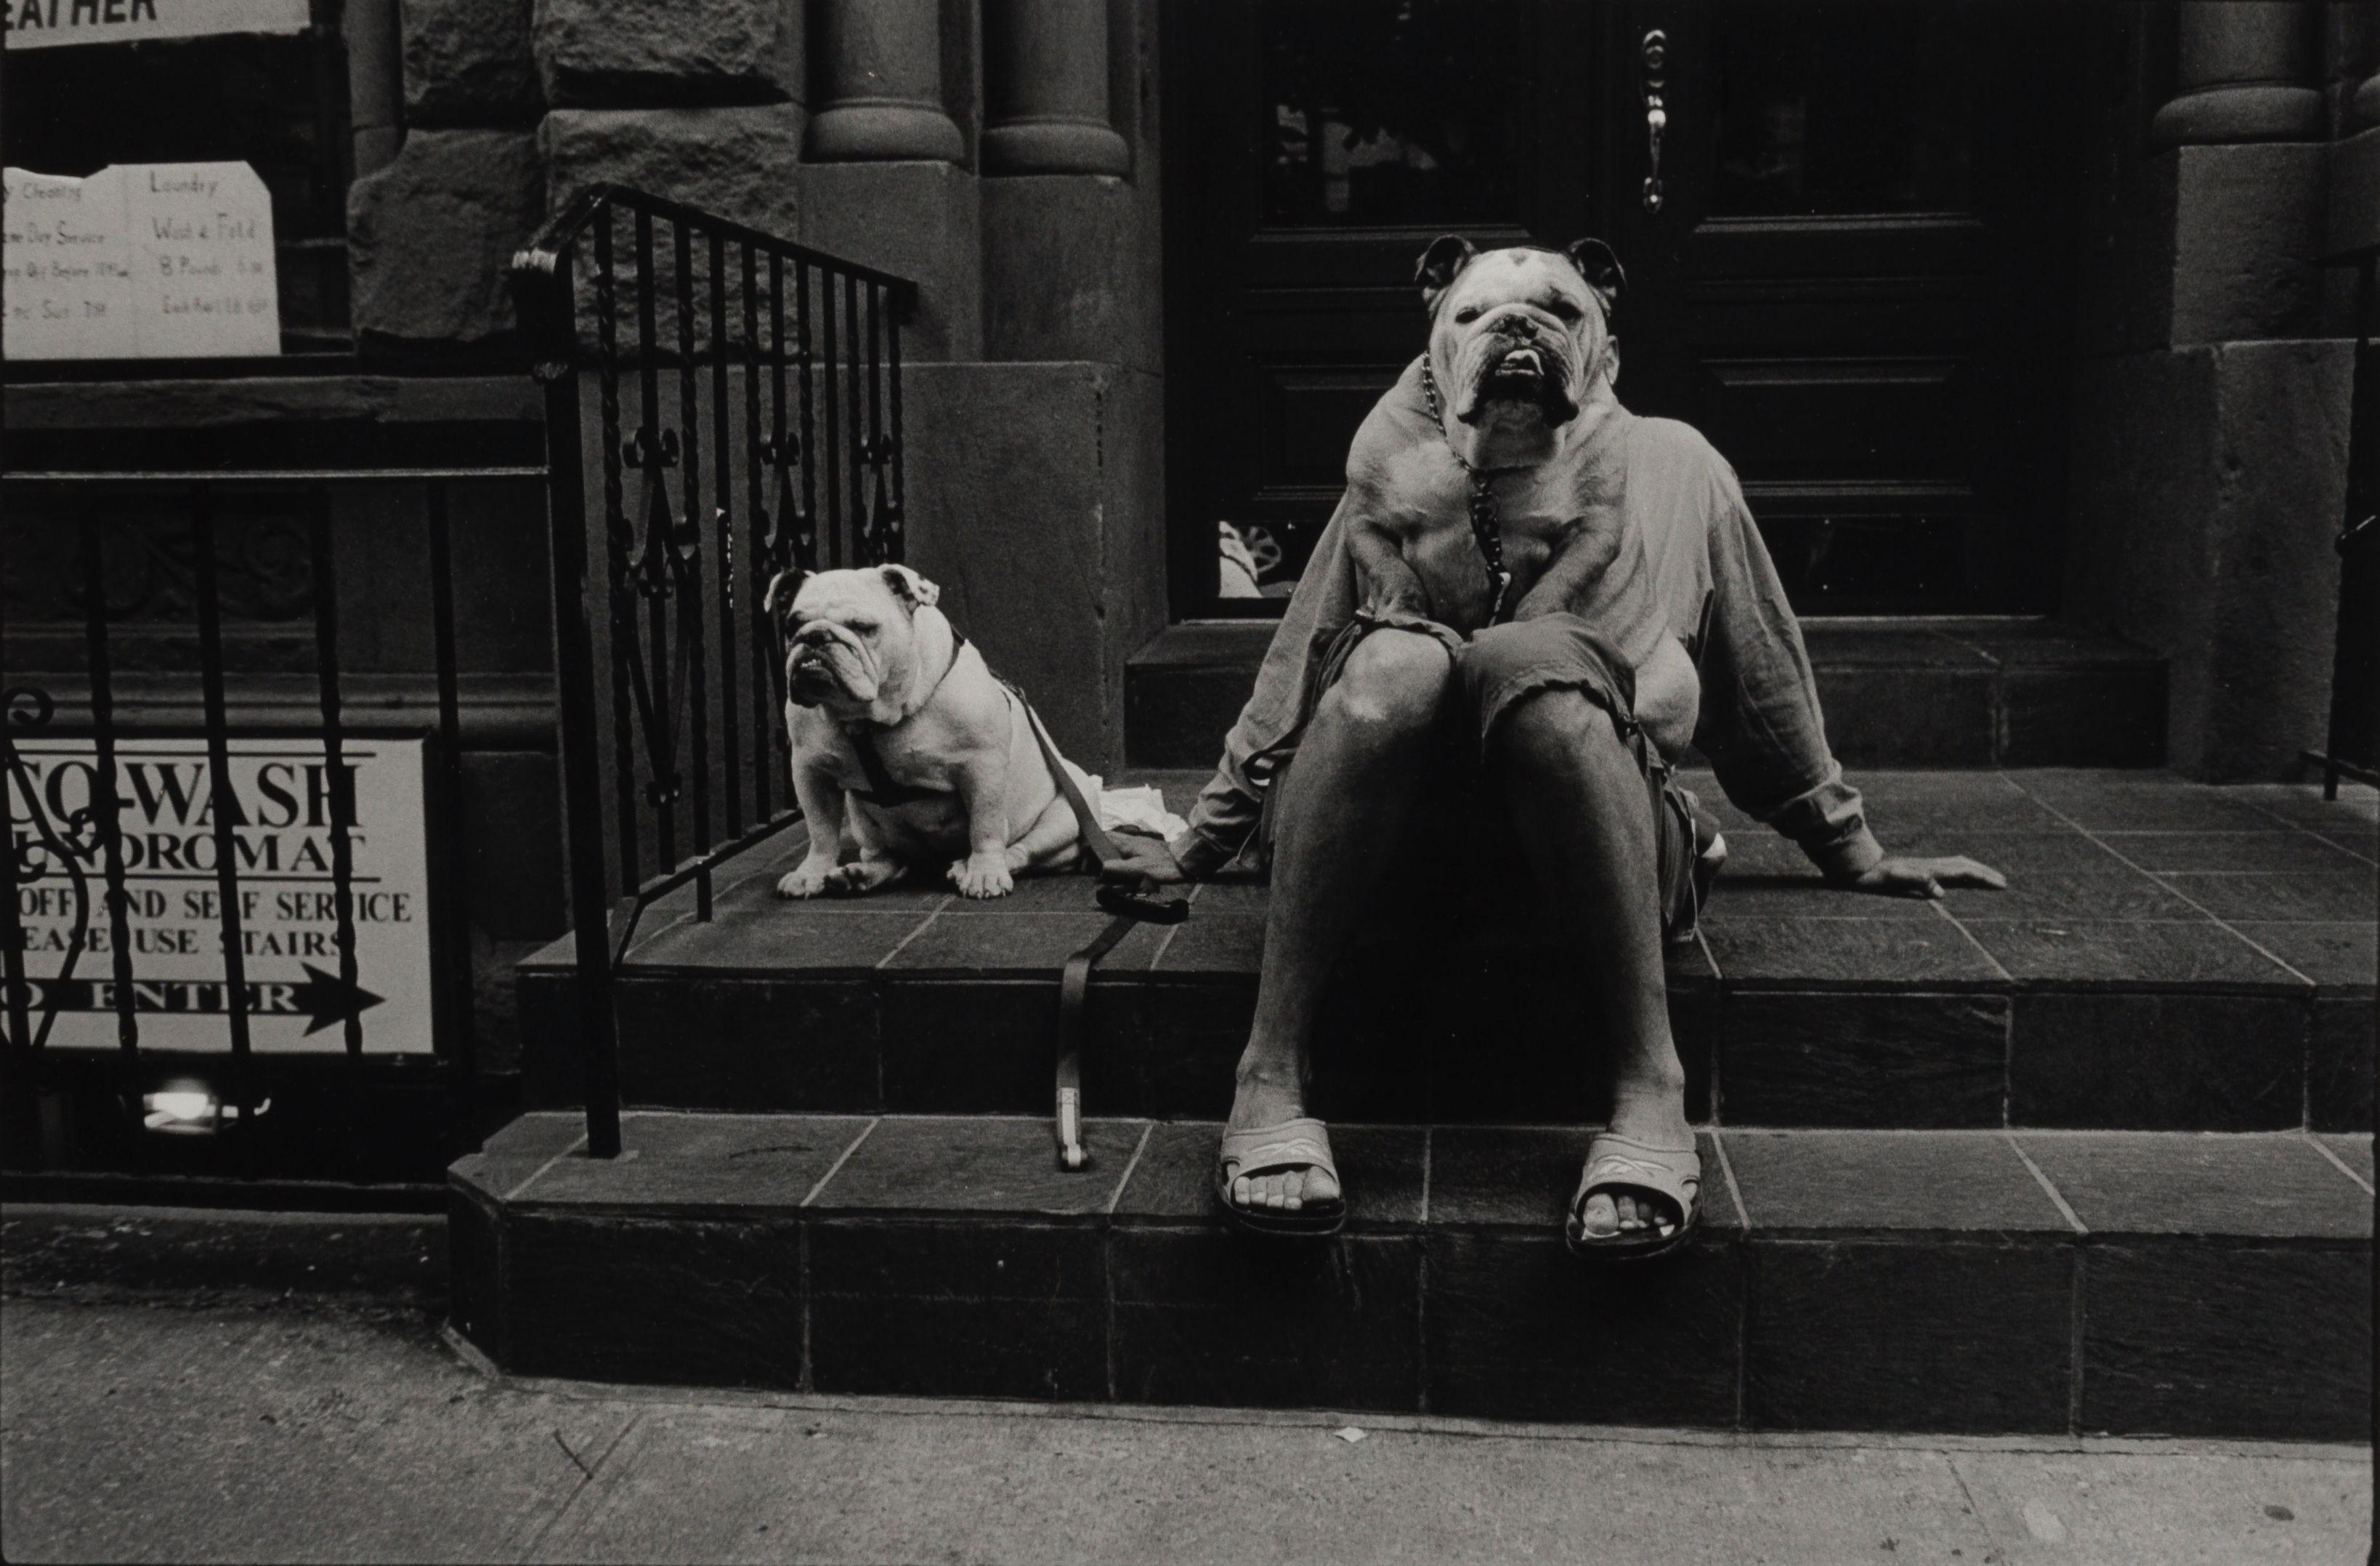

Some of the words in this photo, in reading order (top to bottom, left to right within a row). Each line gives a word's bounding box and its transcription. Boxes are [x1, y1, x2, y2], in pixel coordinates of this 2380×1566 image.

[96, 888, 166, 919] ND
[183, 890, 259, 920] SEF
[276, 891, 412, 924] SERICE
[24, 925, 110, 953] EAE
[135, 927, 198, 954] USE
